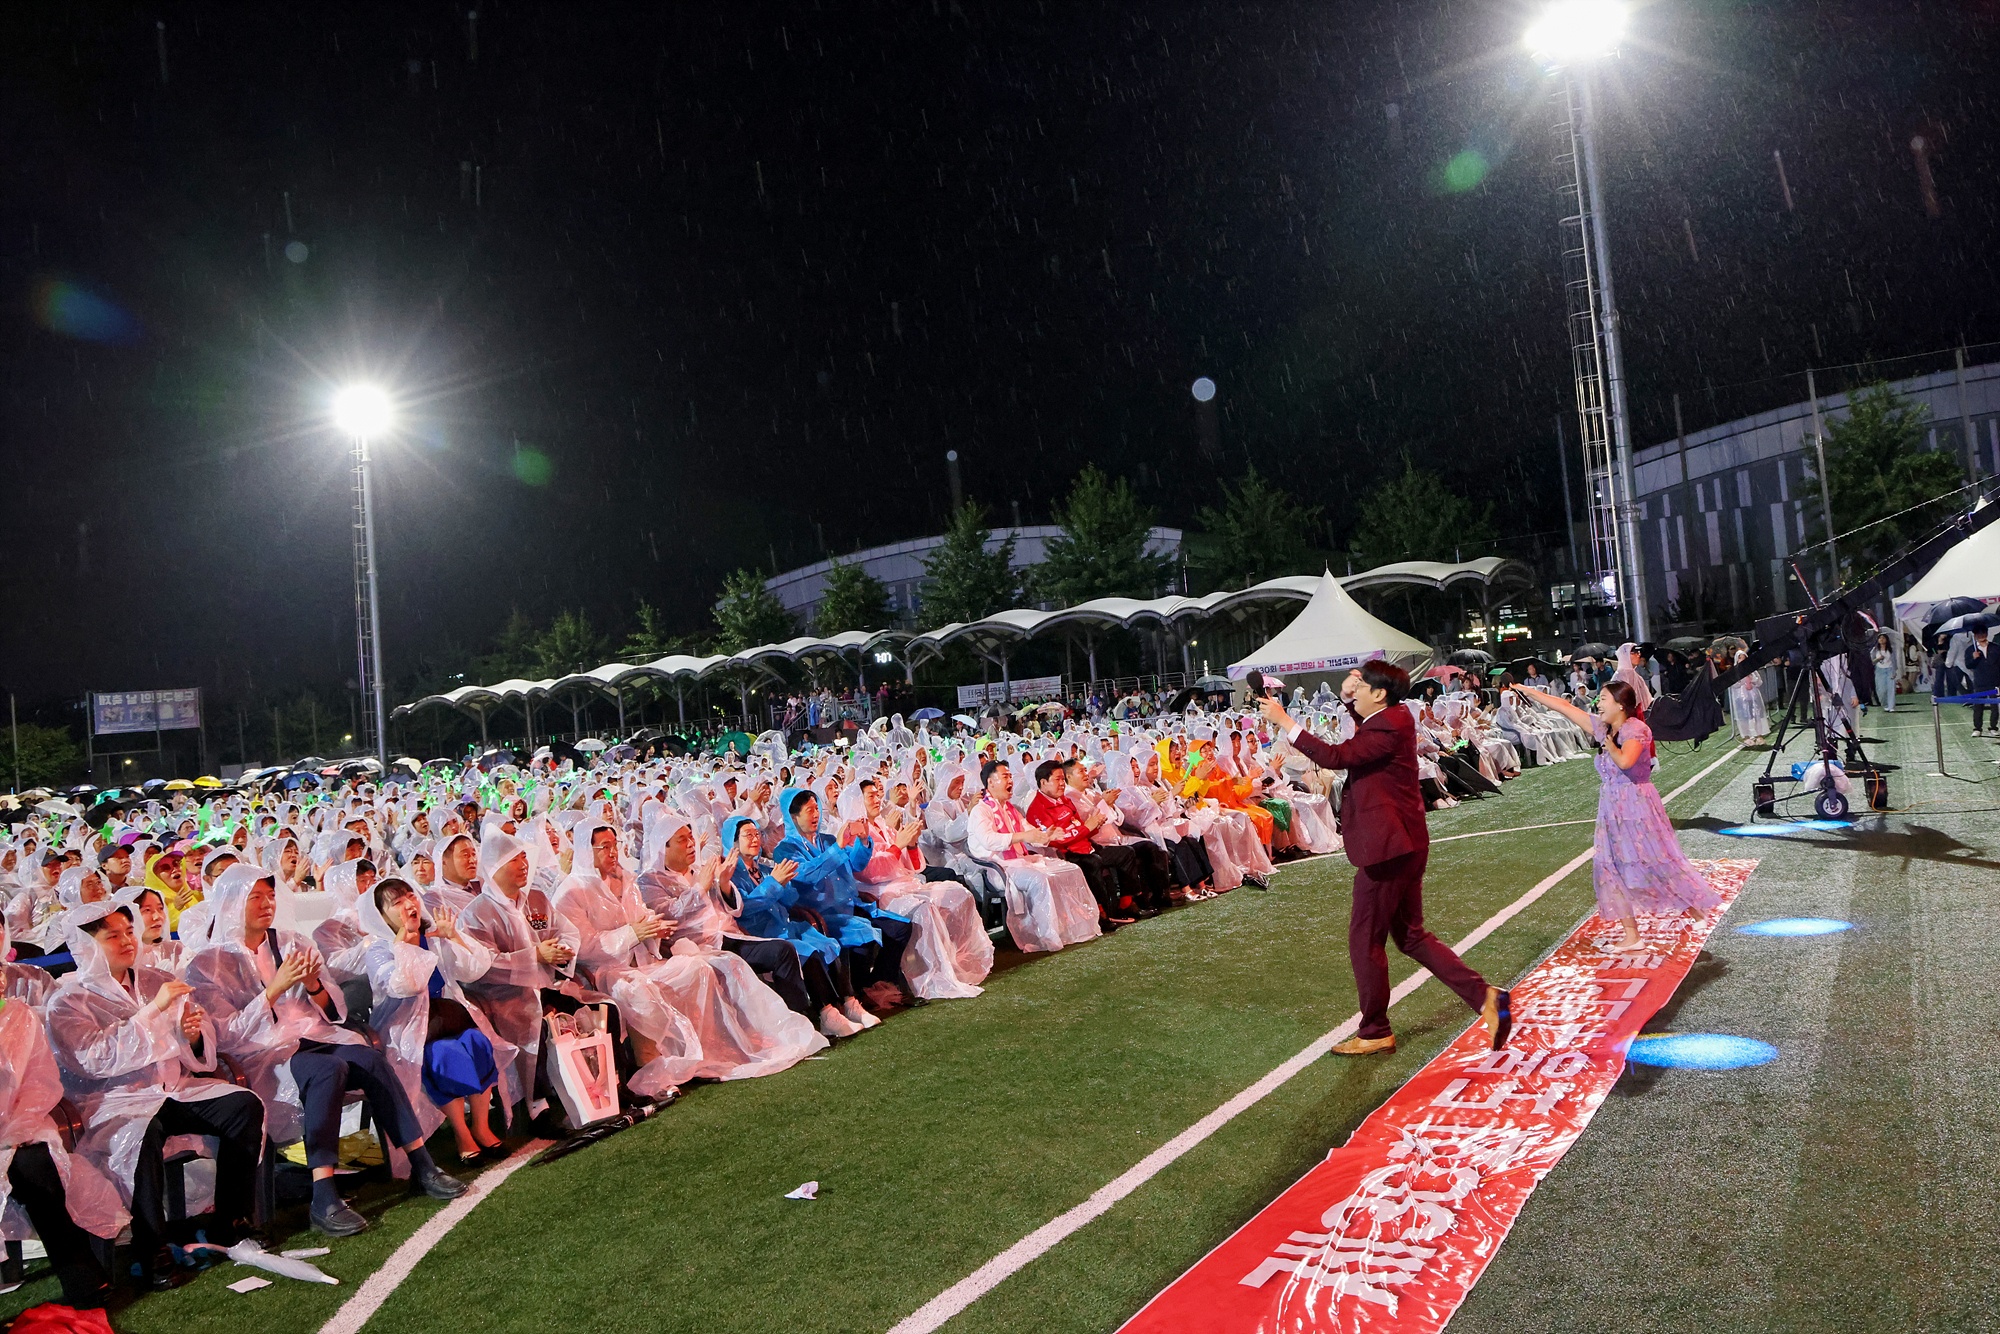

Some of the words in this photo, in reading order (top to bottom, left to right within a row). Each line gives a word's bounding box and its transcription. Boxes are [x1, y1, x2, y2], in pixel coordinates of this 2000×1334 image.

[1279, 661, 1316, 672] 도봉구민의
[1317, 660, 1325, 668] 날
[1327, 656, 1358, 667] 기념축제
